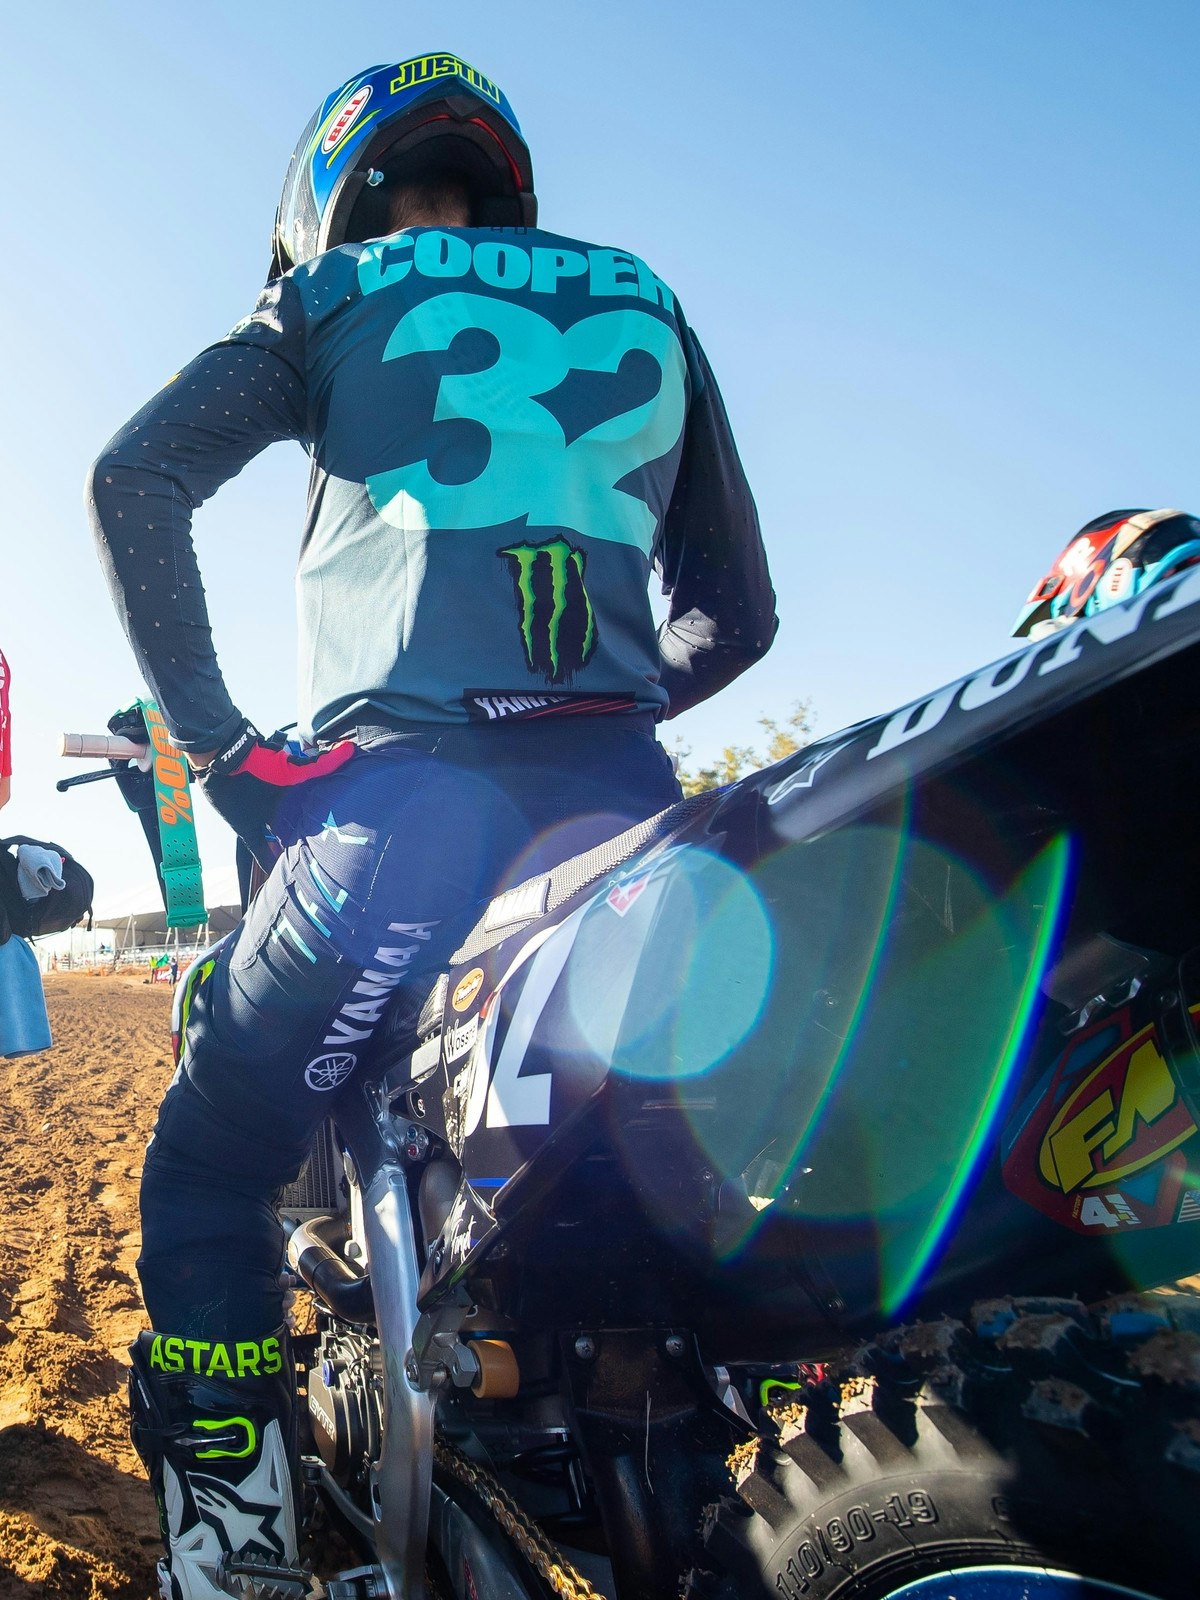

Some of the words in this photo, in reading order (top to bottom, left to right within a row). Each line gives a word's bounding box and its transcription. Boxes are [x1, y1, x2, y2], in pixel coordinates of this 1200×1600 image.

[390, 54, 500, 104] JUSTIN
[328, 94, 368, 142] BELL
[357, 230, 675, 314] COOPER
[365, 291, 686, 559] 32
[474, 696, 572, 720] YAMA
[221, 733, 248, 762] THOR
[323, 919, 442, 1046] YAMAA
[1050, 1037, 1176, 1195] FM
[149, 1335, 283, 1378] ASTARS
